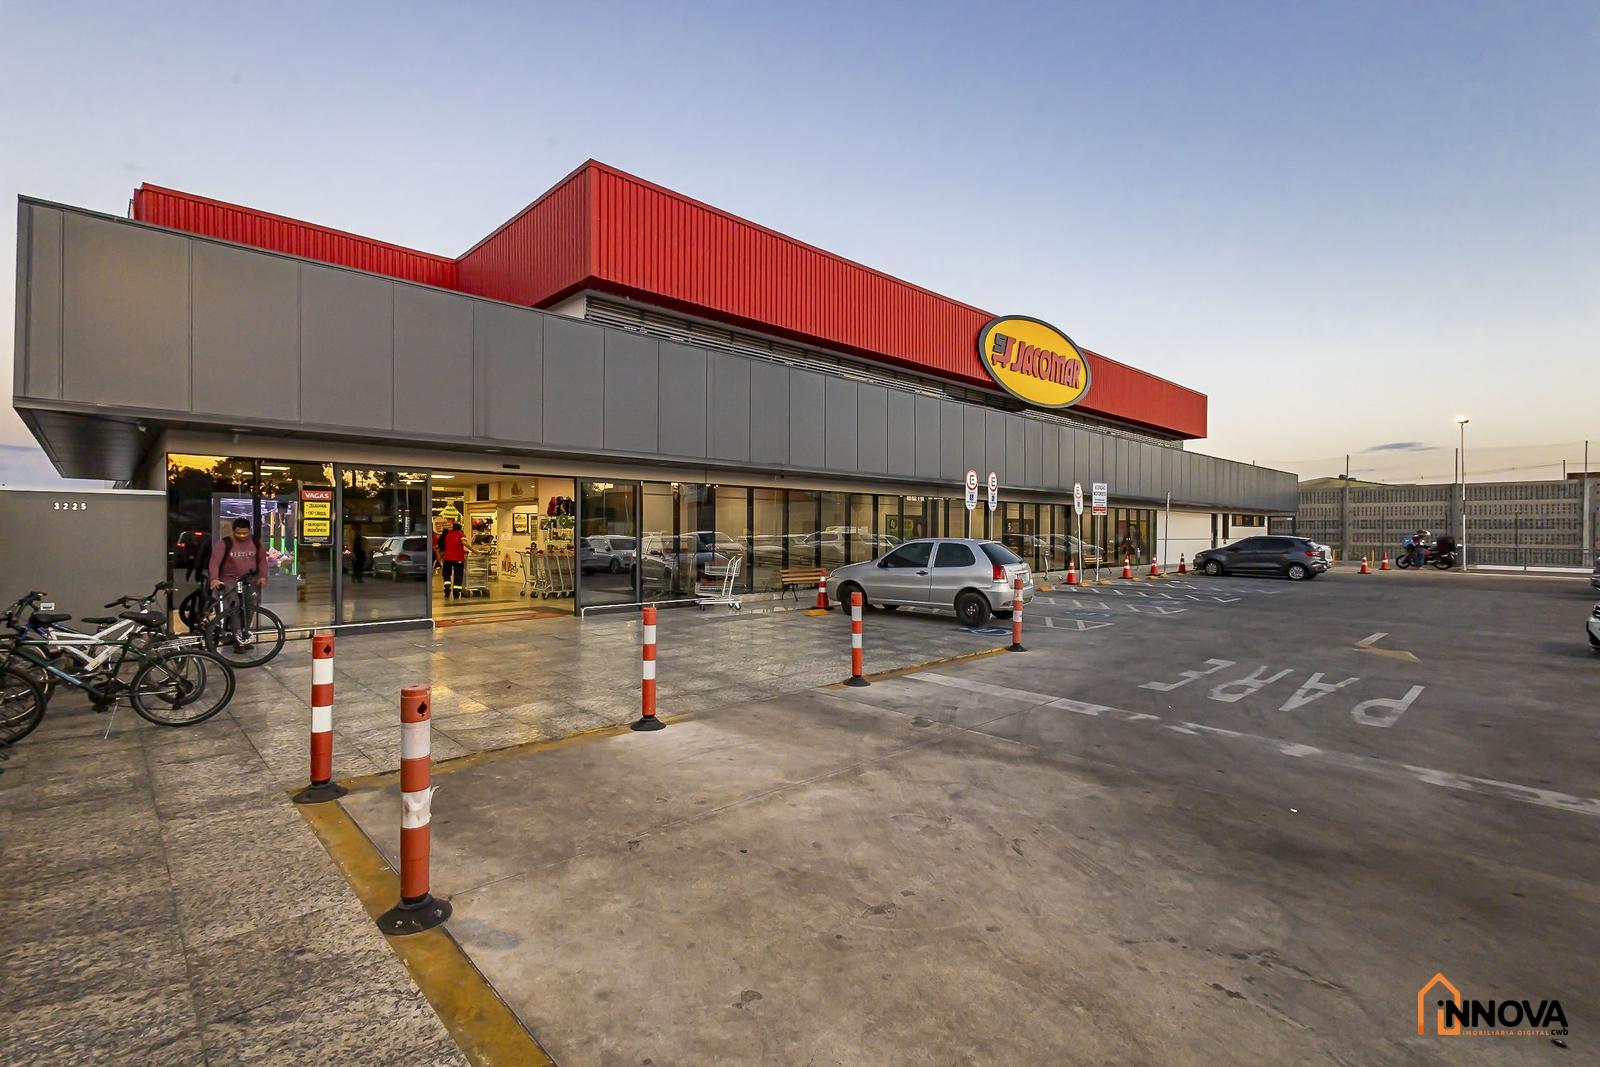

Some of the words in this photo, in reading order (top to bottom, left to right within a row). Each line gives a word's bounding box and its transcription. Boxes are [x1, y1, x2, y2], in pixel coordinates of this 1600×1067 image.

[1010, 341, 1080, 389] JACOMAR
[53, 502, 87, 511] 3225
[1137, 658, 1425, 728] PARE
